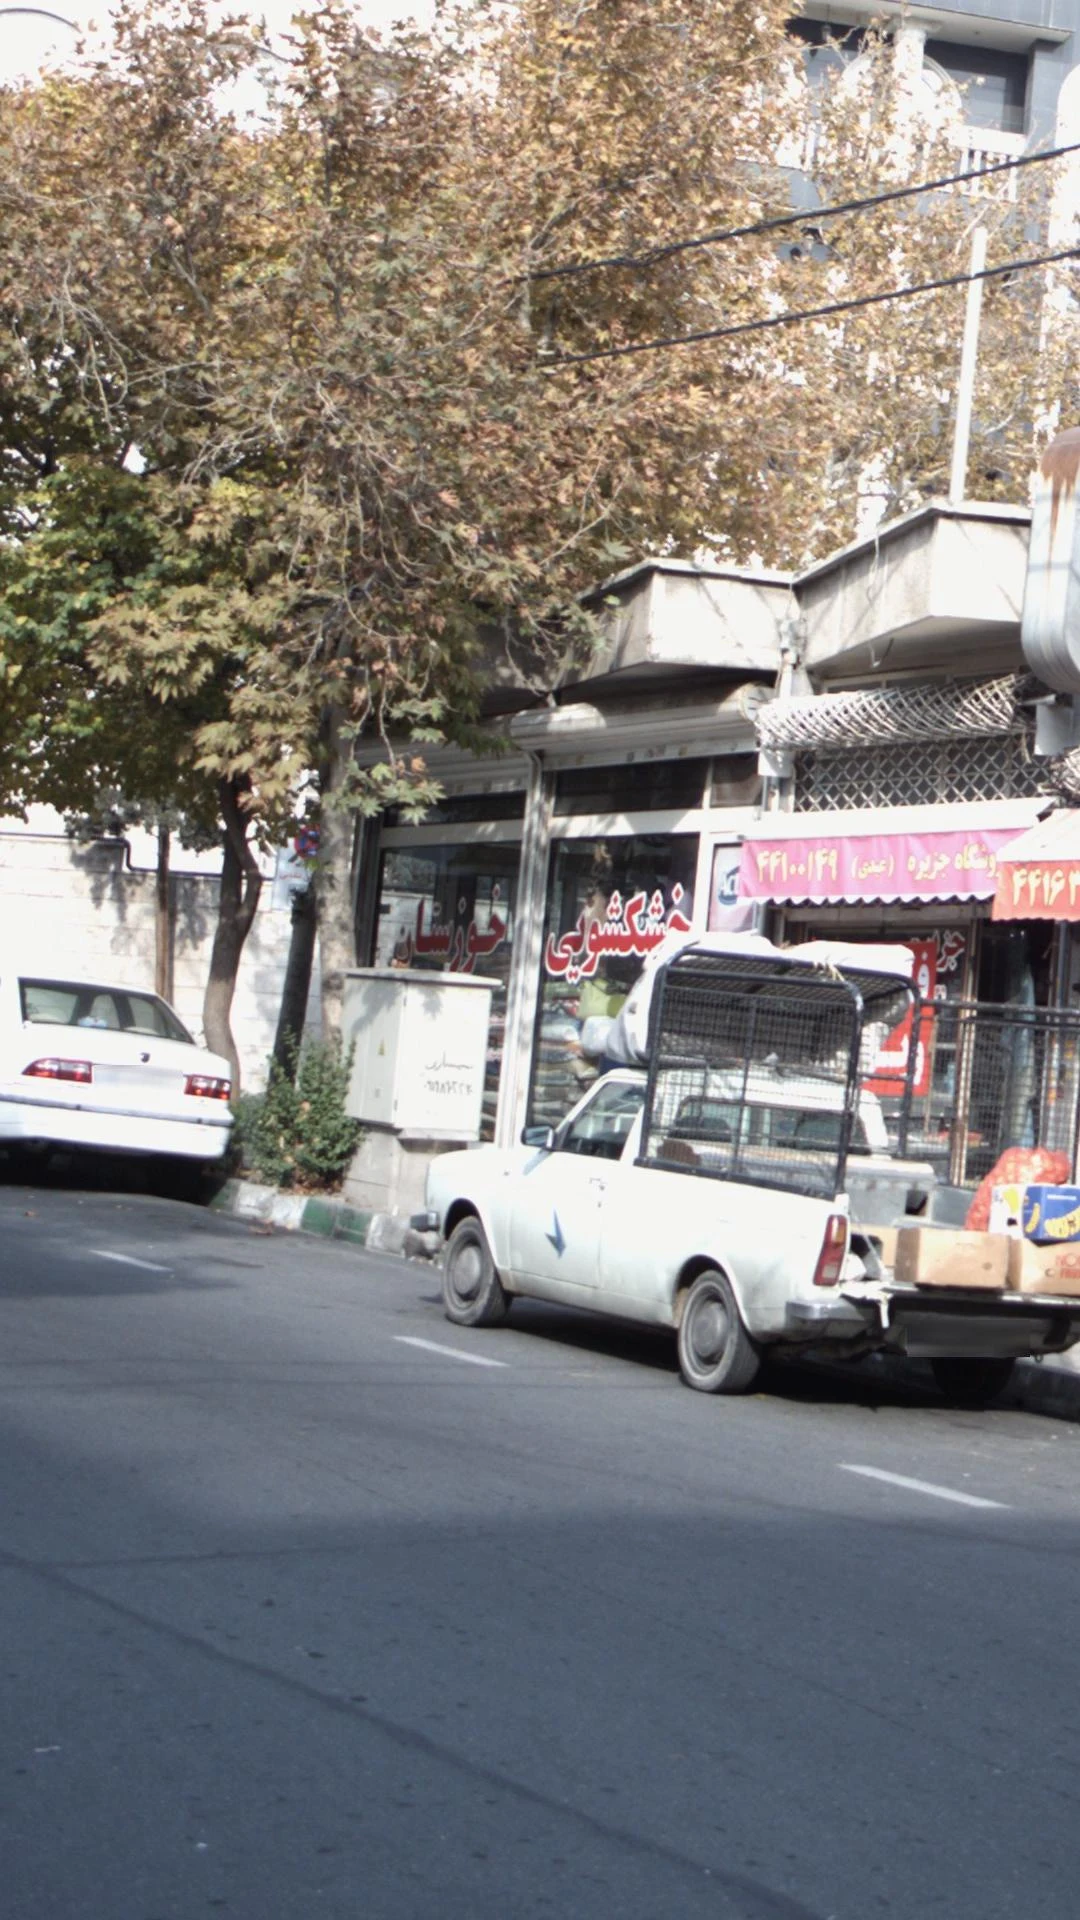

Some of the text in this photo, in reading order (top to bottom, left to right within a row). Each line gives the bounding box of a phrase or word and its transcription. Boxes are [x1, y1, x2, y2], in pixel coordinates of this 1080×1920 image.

[757, 848, 837, 882] ۴۴۱۰۰۱۴۹
[907, 851, 951, 880] جزیره
[954, 843, 1000, 878] وشگاه
[545, 882, 693, 984] خشکشویی
